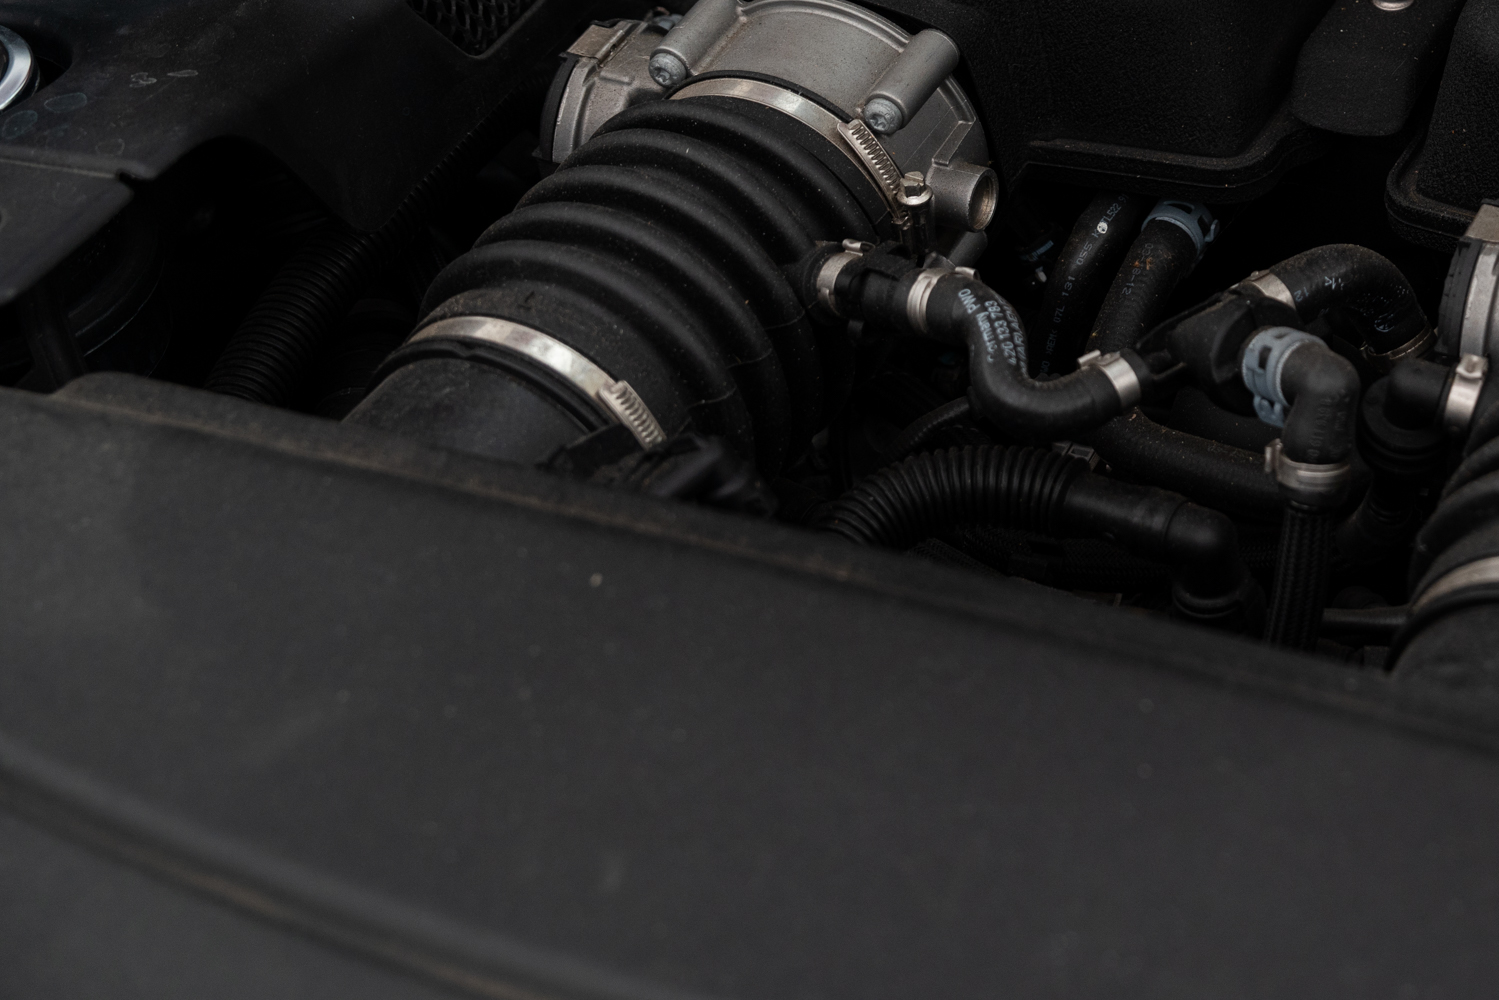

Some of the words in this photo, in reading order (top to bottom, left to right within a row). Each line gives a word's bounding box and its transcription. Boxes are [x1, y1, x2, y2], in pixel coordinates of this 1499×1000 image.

[1062, 275, 1076, 297] 131
[984, 300, 1004, 319] 783
[994, 319, 1011, 341] 133
